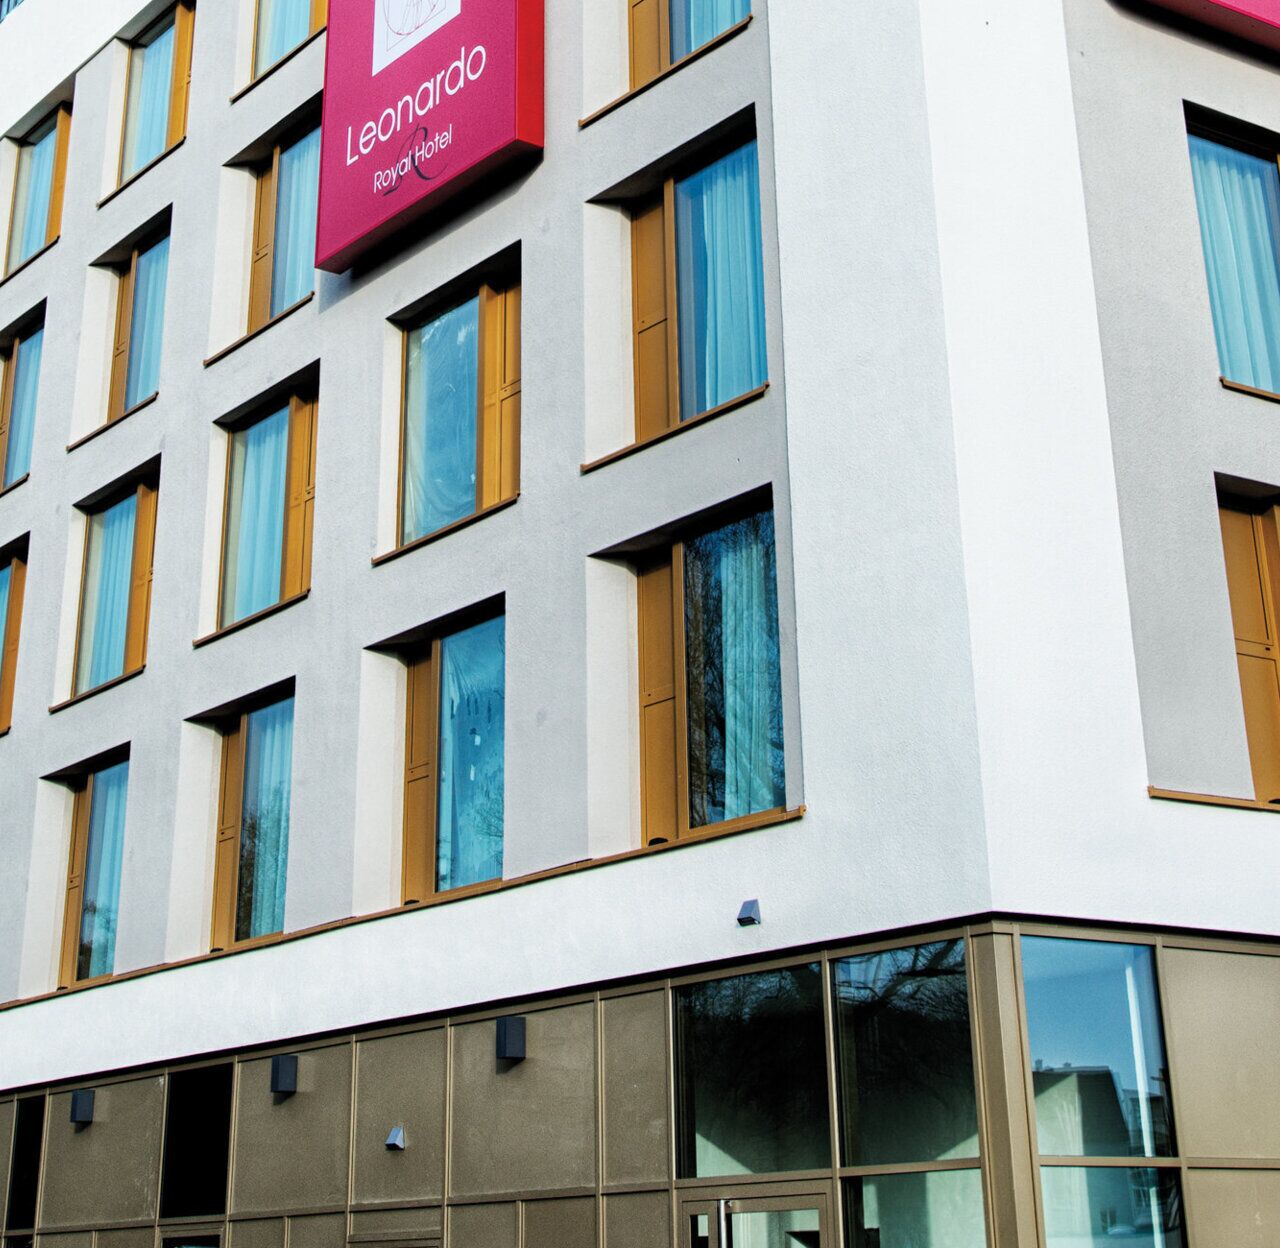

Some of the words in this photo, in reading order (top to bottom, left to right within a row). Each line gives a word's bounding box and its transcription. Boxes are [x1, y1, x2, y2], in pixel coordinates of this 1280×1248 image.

[346, 45, 487, 167] Leonardo
[373, 149, 412, 193] Royal
[415, 123, 453, 167] Hotel
